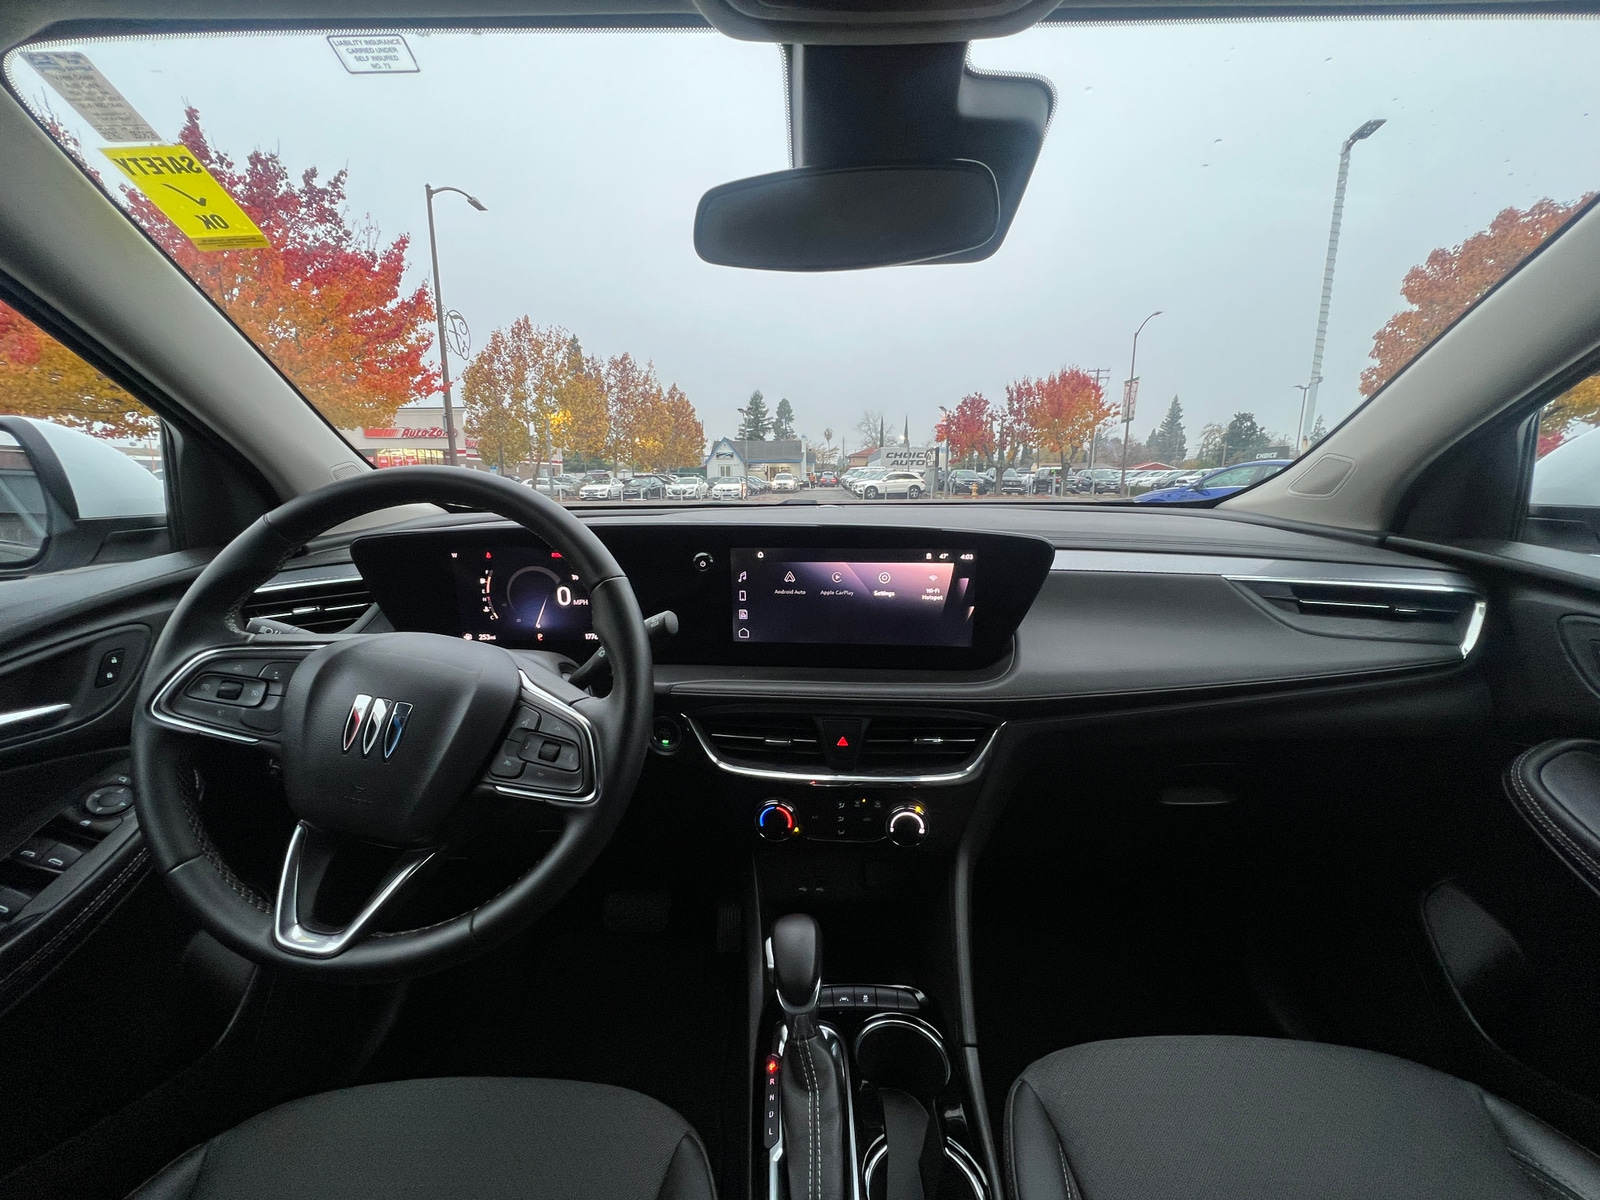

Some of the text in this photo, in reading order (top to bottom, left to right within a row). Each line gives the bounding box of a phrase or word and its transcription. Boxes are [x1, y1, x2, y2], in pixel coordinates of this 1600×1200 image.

[364, 38, 402, 46] INSURANCE
[375, 46, 399, 54] UNDER
[556, 586, 572, 606] 0
[873, 590, 896, 598] Settings
[921, 594, 944, 602] Hotspot
[768, 1110, 774, 1118] D
[768, 1127, 773, 1135] L
